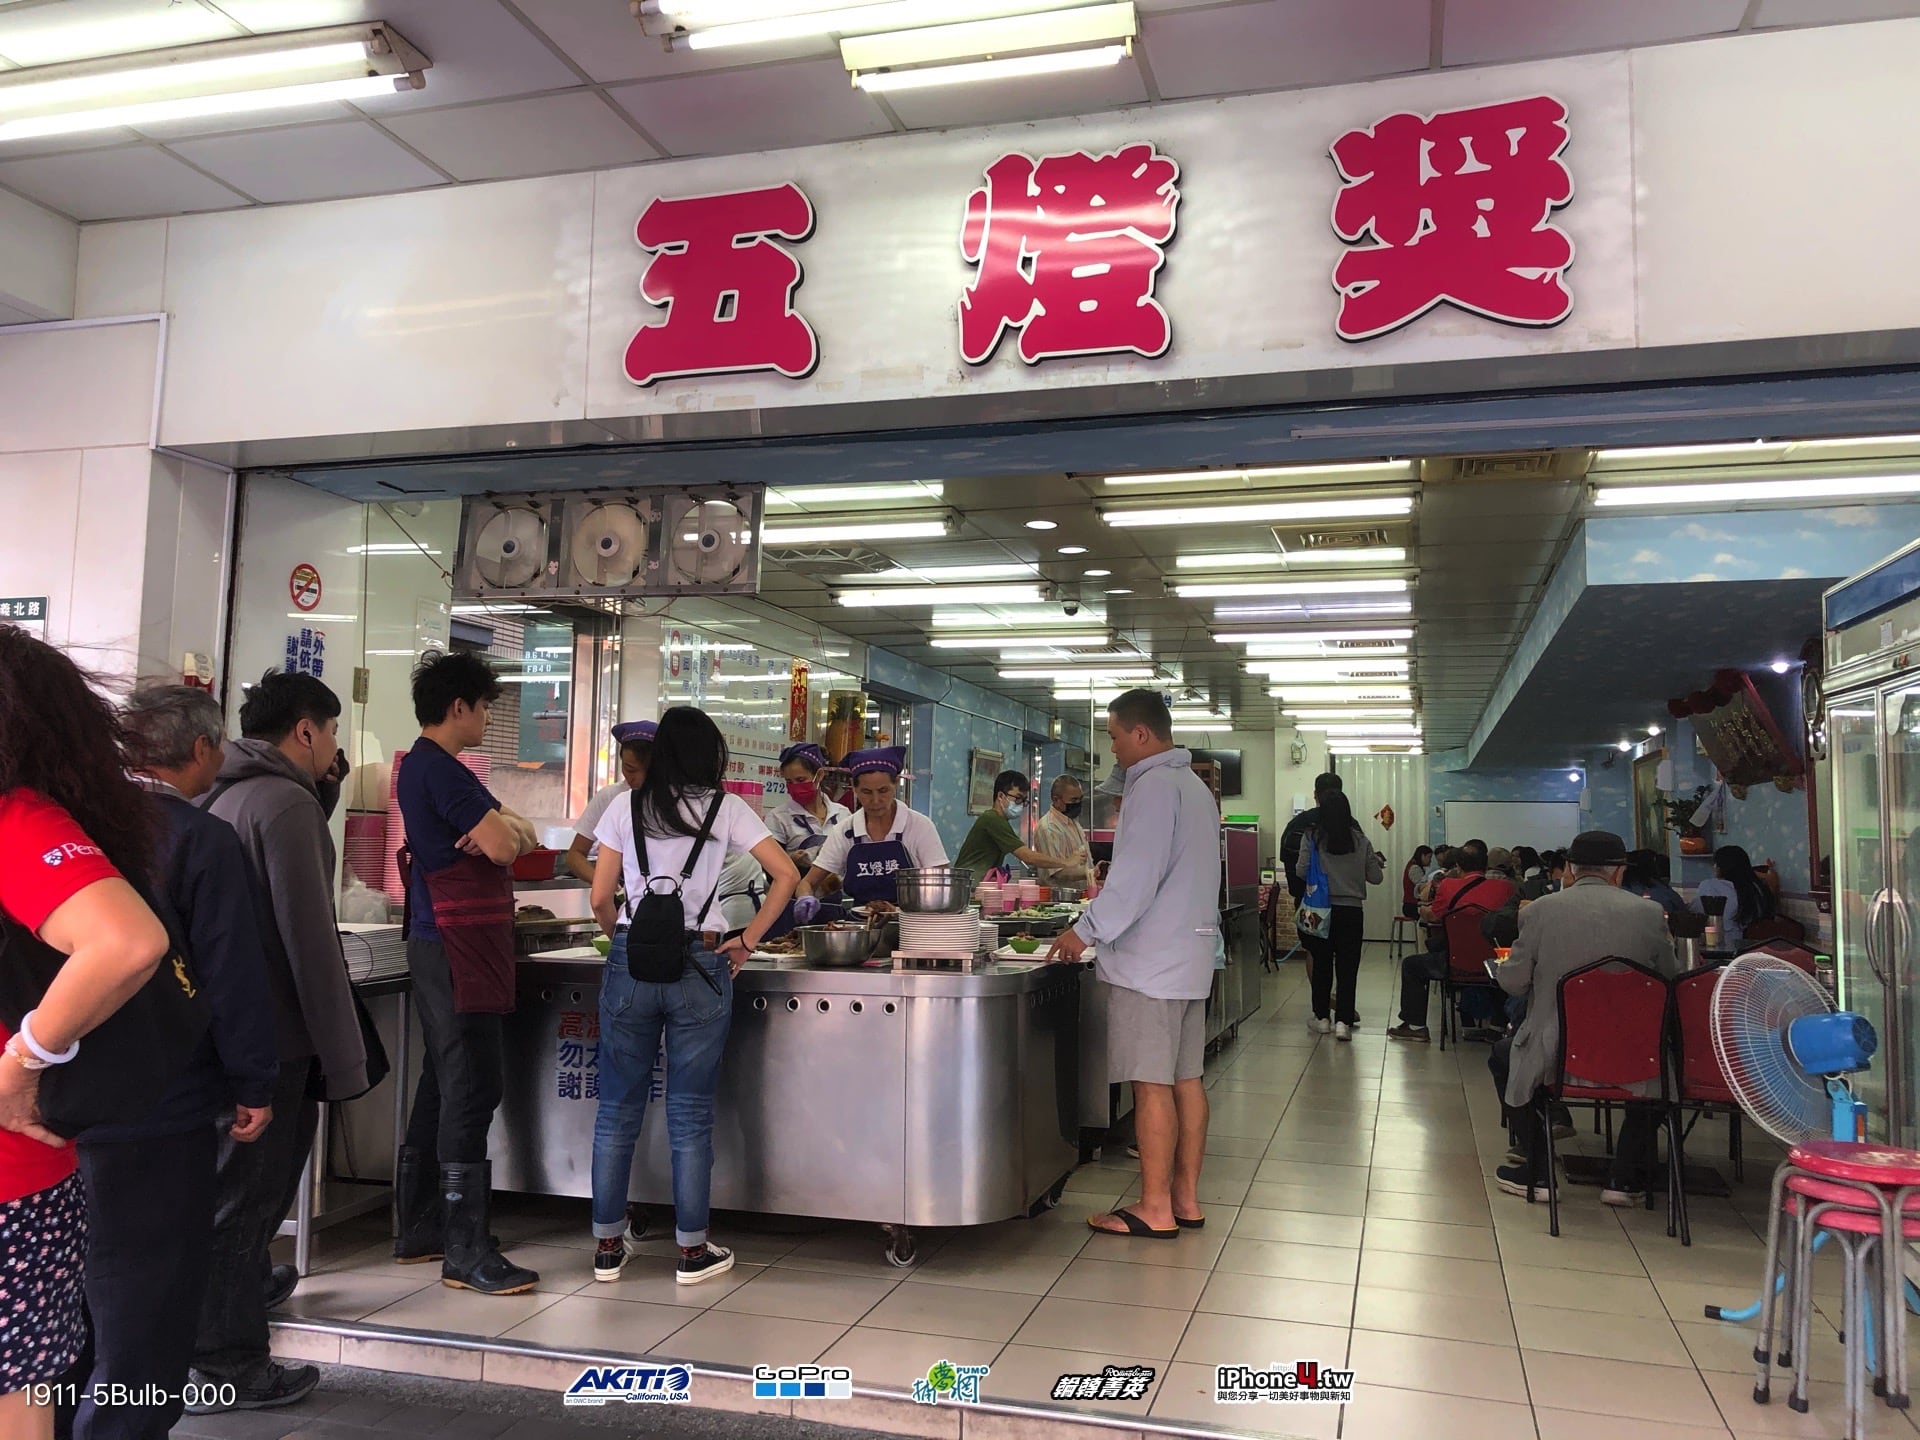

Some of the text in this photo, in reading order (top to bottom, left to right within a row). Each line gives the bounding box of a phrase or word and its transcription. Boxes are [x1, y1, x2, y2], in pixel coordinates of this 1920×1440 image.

[623, 96, 1577, 387] 五燈獎
[300, 628, 312, 674] 請依
